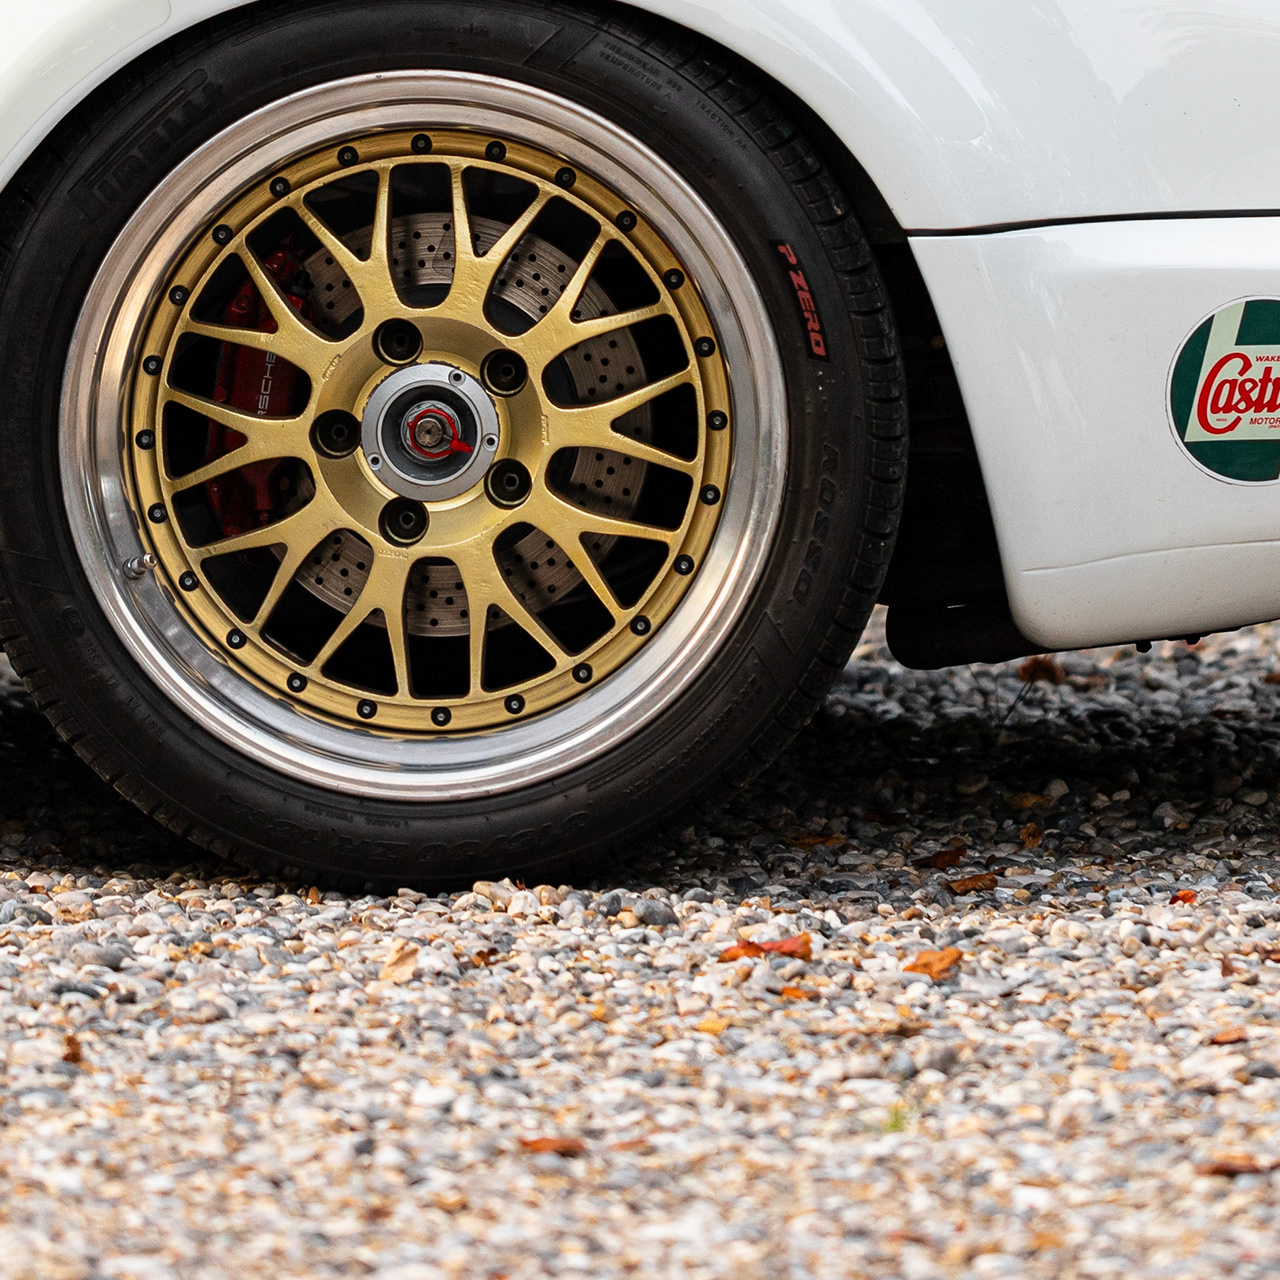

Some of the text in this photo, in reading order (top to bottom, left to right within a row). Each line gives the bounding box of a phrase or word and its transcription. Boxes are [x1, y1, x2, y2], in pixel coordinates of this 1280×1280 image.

[597, 50, 664, 93] TEMPERATURE
[693, 98, 749, 152] TRACTION AA
[778, 243, 826, 356] P ZERO
[258, 352, 276, 415] SCHE
[791, 443, 842, 601] ROSSO
